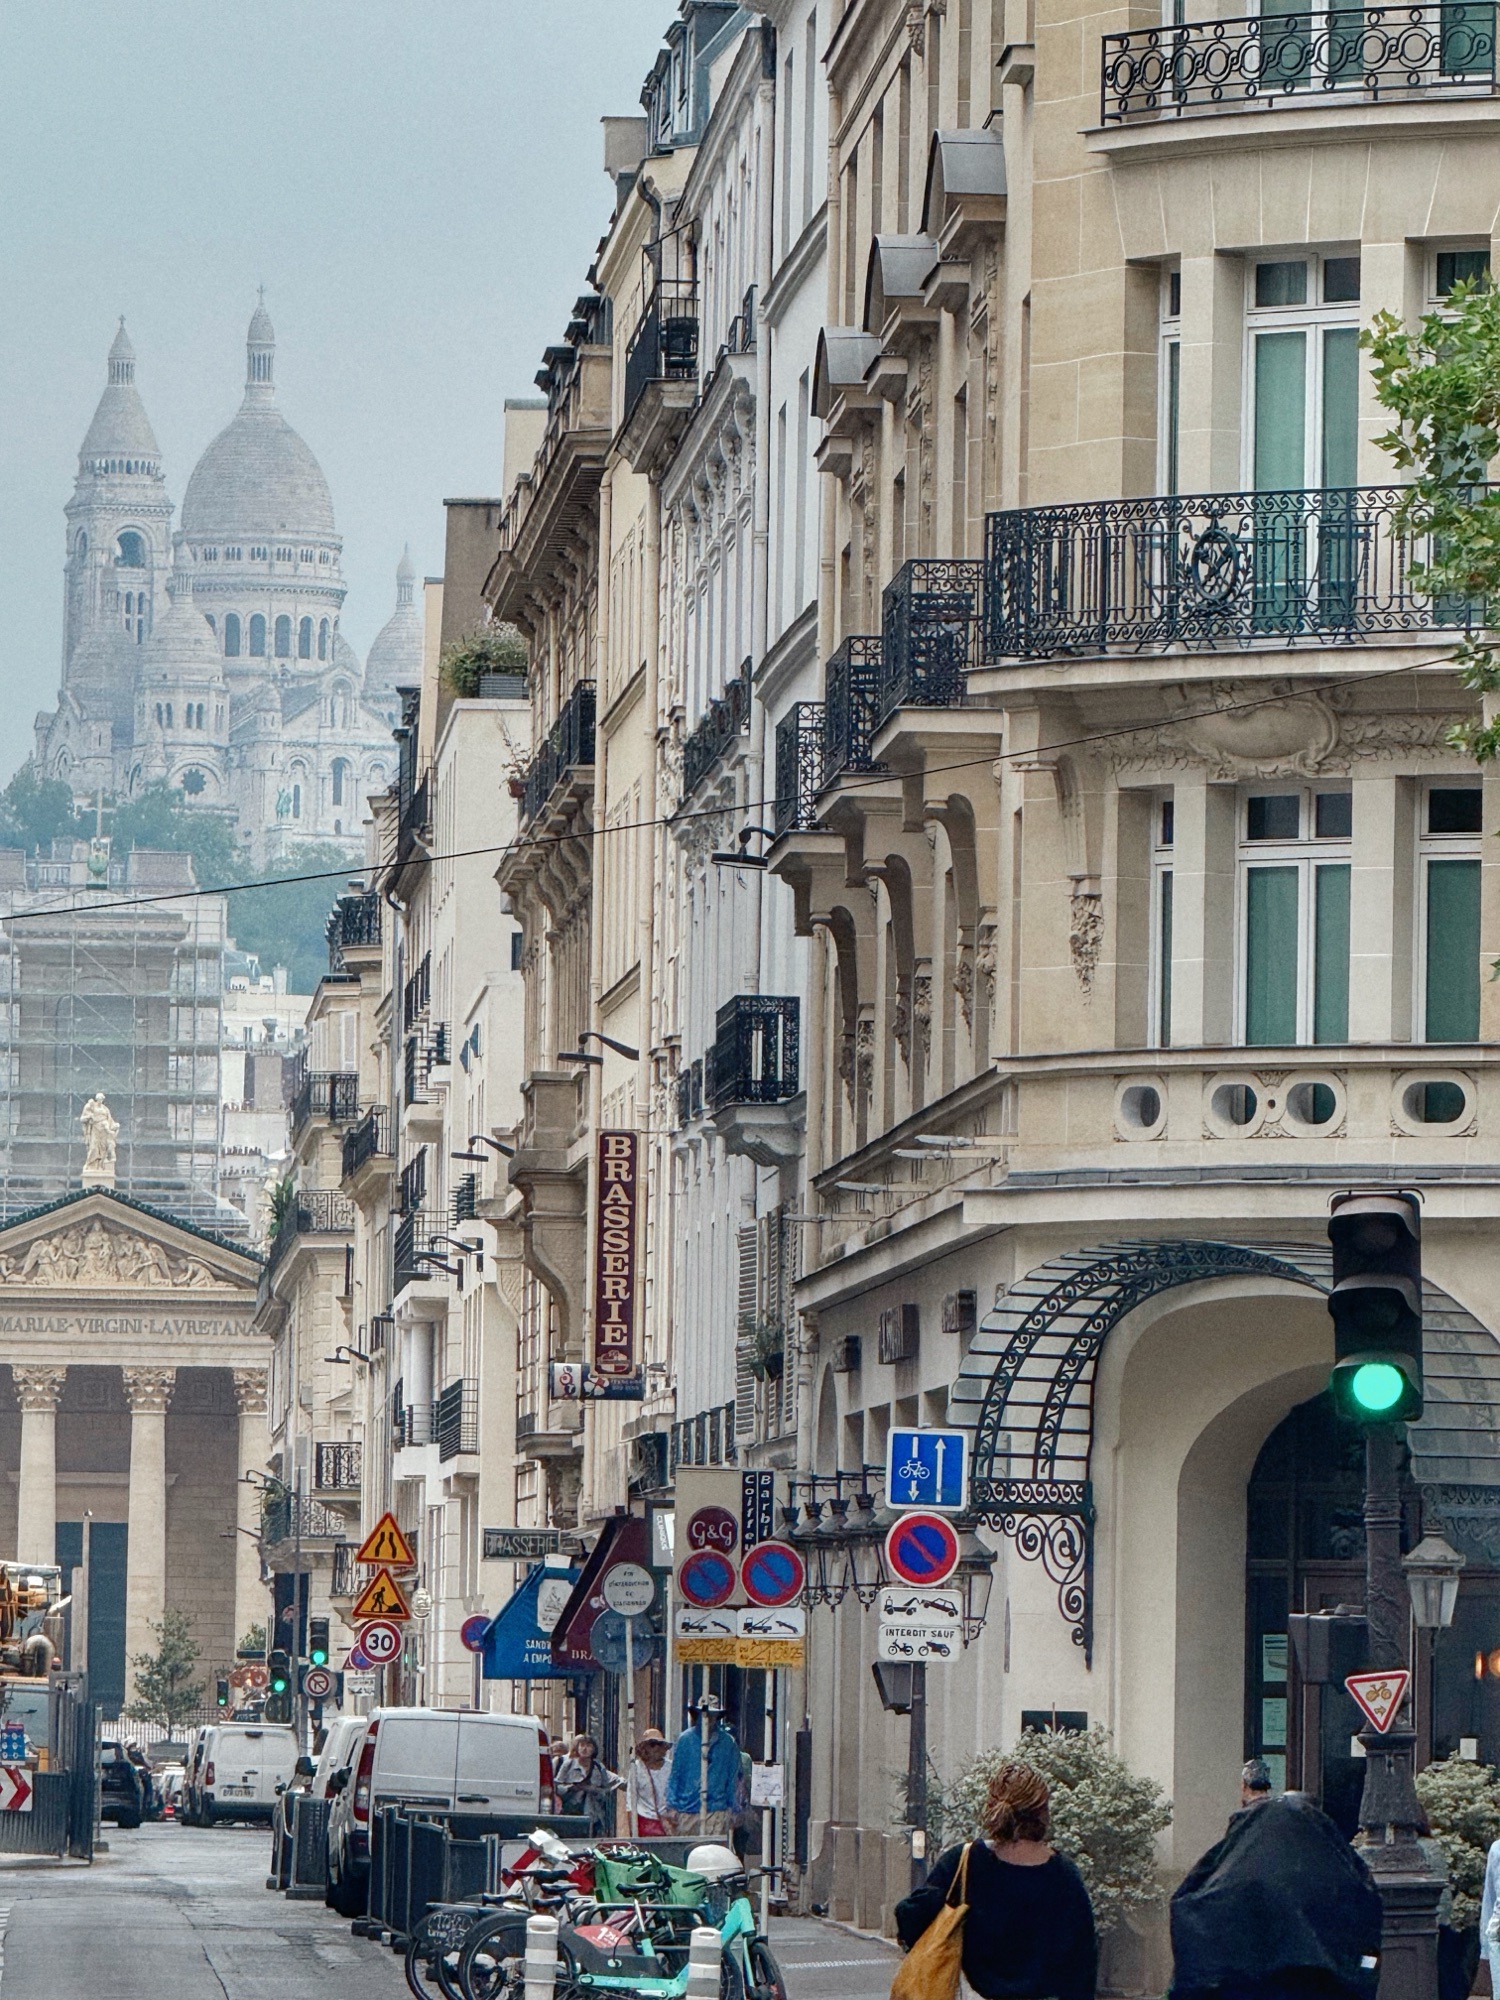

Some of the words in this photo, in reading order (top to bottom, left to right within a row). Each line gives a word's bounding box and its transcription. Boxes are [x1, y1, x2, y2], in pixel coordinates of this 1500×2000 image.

[600, 1136, 633, 1346] BRASSERIE
[78, 1318, 144, 1334] VIRGINI
[149, 1319, 268, 1336] LAVRETANA
[692, 1521, 733, 1546] G&G
[368, 1633, 394, 1652] 30
[885, 1628, 927, 1638] INTERDIT
[931, 1630, 955, 1639] SAUF
